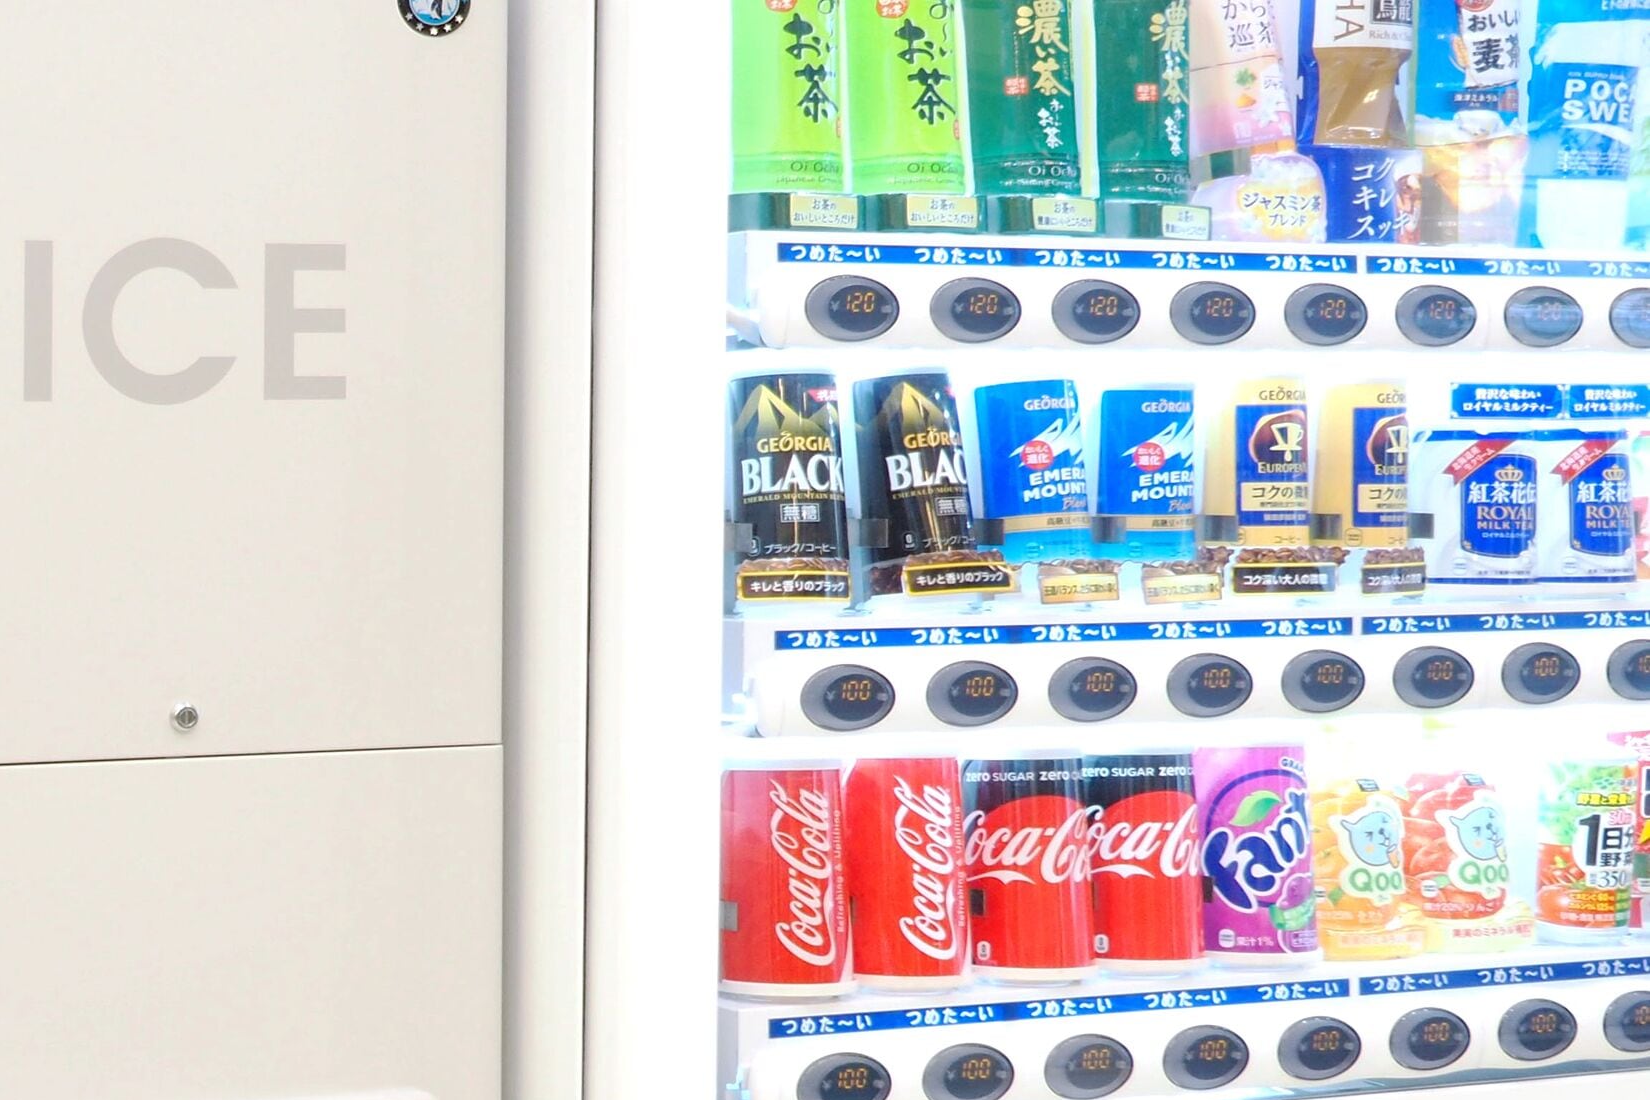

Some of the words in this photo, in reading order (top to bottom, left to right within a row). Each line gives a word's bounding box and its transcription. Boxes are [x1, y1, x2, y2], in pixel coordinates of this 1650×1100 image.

[1561, 100, 1634, 123] SWE
[1242, 191, 1322, 211] ジャスミン茶
[1588, 262, 1650, 277] つめた〜
[845, 292, 875, 313] 120
[969, 294, 998, 315] 120
[1090, 296, 1118, 316] 120
[1206, 297, 1234, 317] 120
[23, 236, 347, 406] ICE
[757, 430, 834, 454] GEORGIA
[741, 453, 845, 496] BLACK
[750, 579, 846, 594] キレと香りのブラック
[1584, 612, 1650, 628] つめた〜
[965, 771, 991, 782] zero
[992, 771, 1035, 782] SUGAR
[1111, 766, 1154, 777] SUGAR
[1158, 765, 1187, 776] zero
[769, 778, 837, 967] Coca-Cola
[893, 774, 957, 961] Coca-Cola
[1459, 860, 1509, 885] Qoo
[1582, 957, 1650, 976] つめた〜
